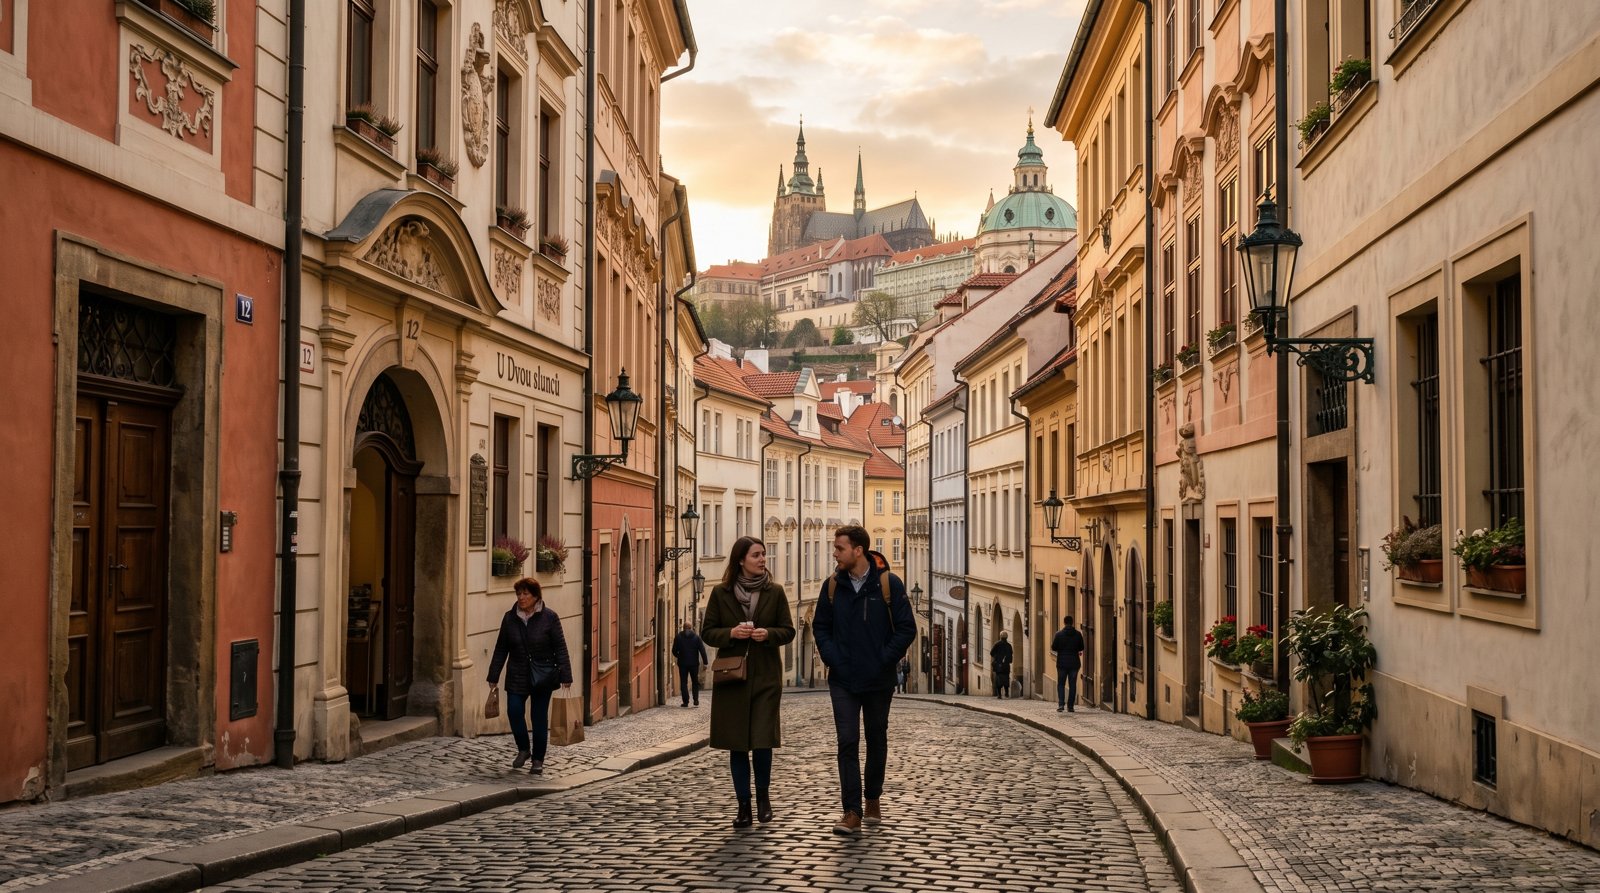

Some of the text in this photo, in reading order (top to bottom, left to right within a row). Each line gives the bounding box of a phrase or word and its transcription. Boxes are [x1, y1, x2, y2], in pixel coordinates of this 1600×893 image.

[241, 300, 250, 318] 12
[406, 320, 420, 340] 12
[304, 348, 311, 365] 12
[497, 352, 505, 378] U
[508, 356, 531, 388] Dvou
